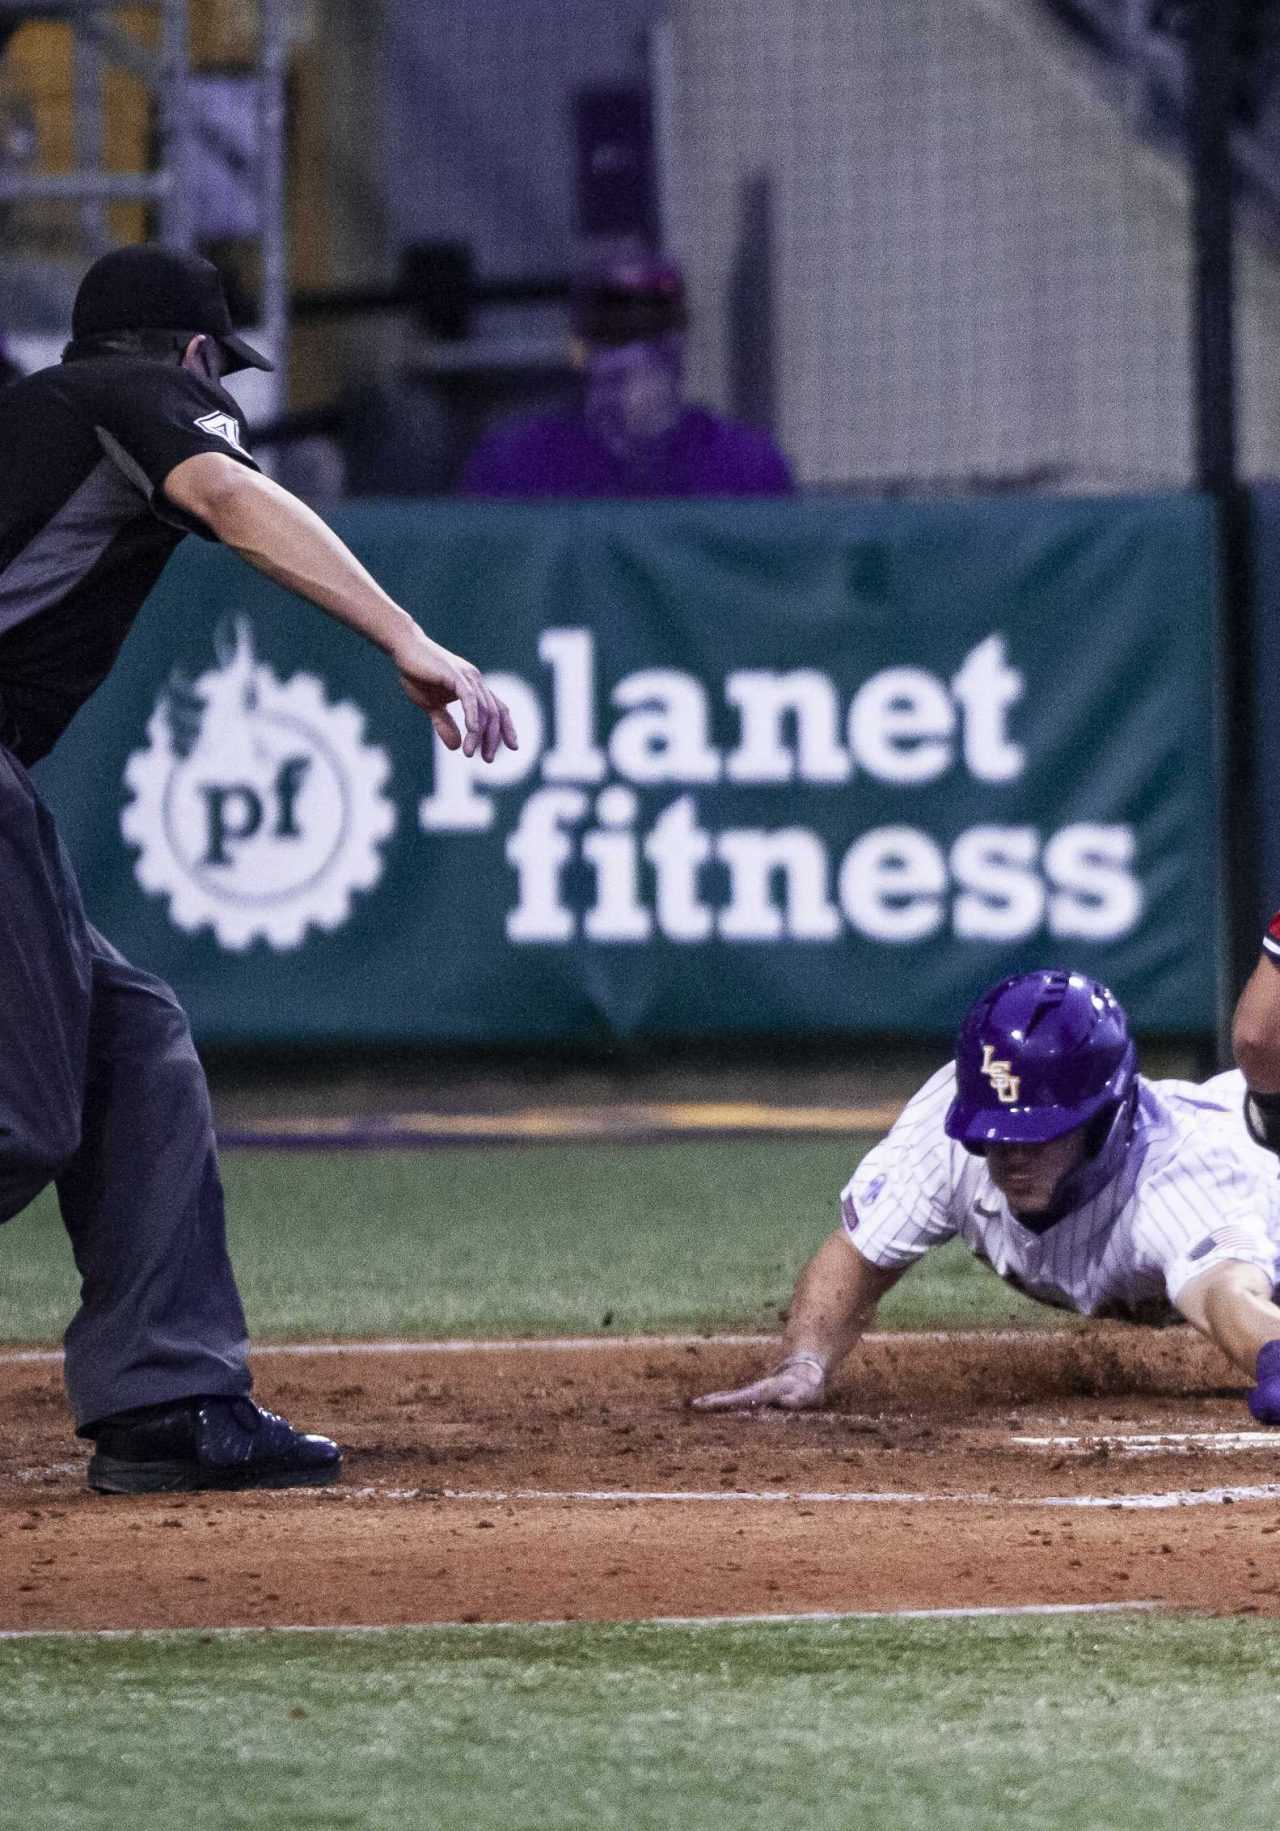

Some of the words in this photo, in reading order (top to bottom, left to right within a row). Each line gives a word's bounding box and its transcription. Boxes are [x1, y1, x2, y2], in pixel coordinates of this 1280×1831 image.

[417, 629, 1026, 832] planet
[199, 755, 313, 867] pf
[505, 785, 1145, 943] fitness
[980, 1044, 1021, 1103] LSU
